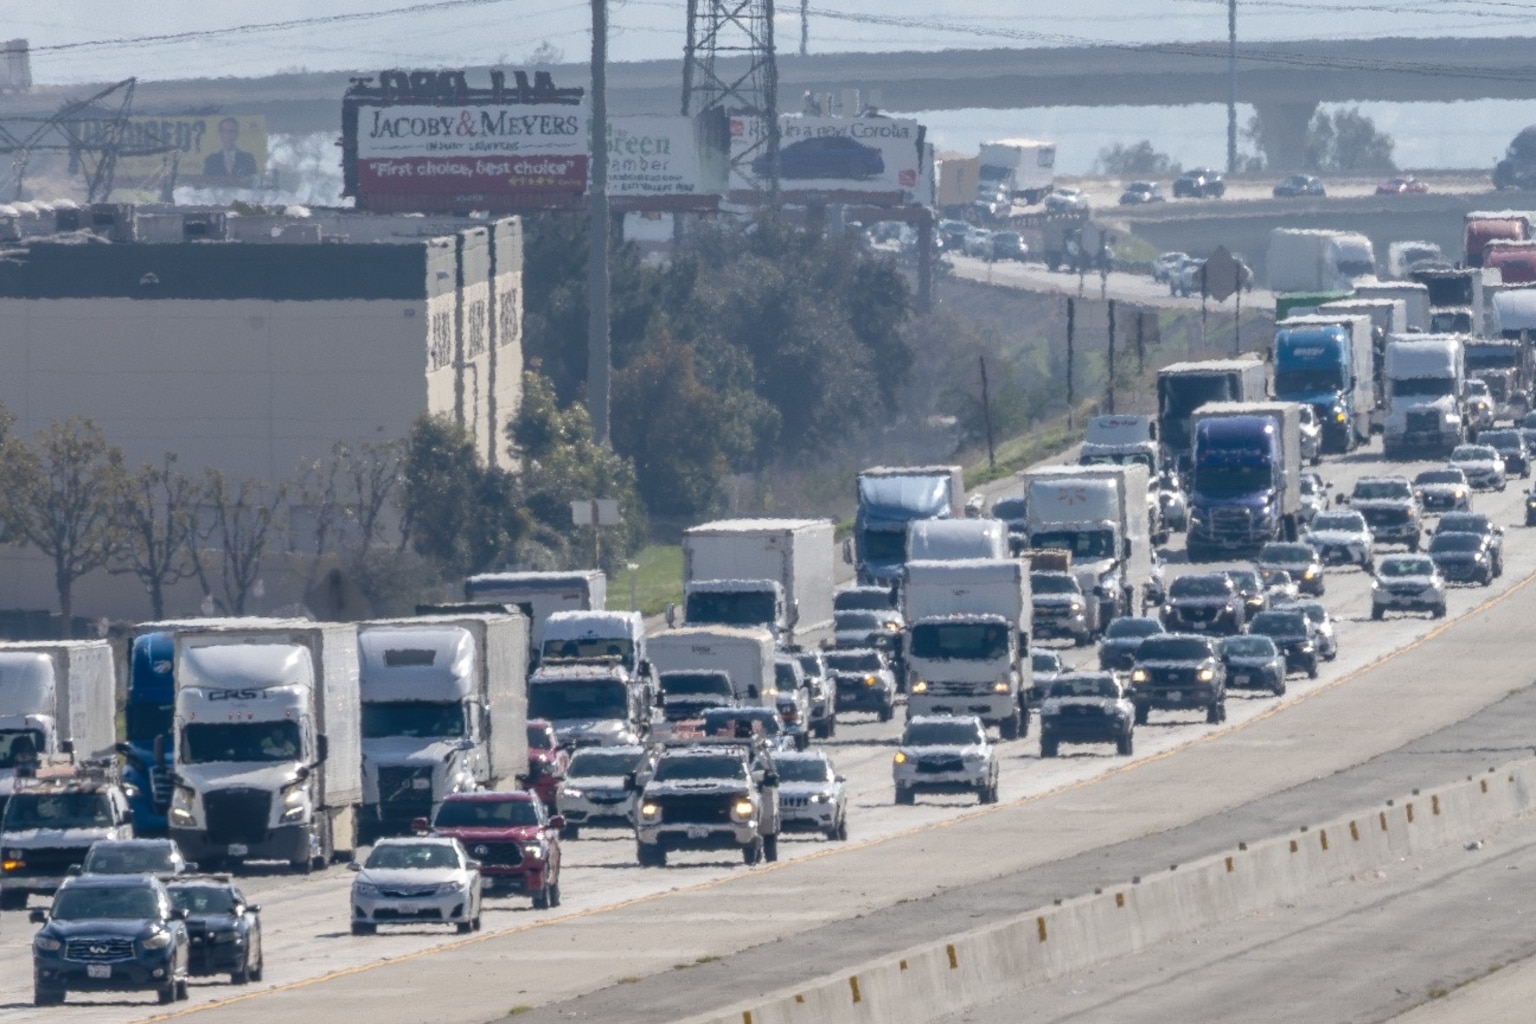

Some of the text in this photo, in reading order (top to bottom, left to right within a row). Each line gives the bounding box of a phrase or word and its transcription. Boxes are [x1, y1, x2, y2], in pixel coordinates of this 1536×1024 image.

[370, 110, 455, 138] JACOBY
[480, 110, 579, 137] MEYERS
[476, 159, 510, 175] best
